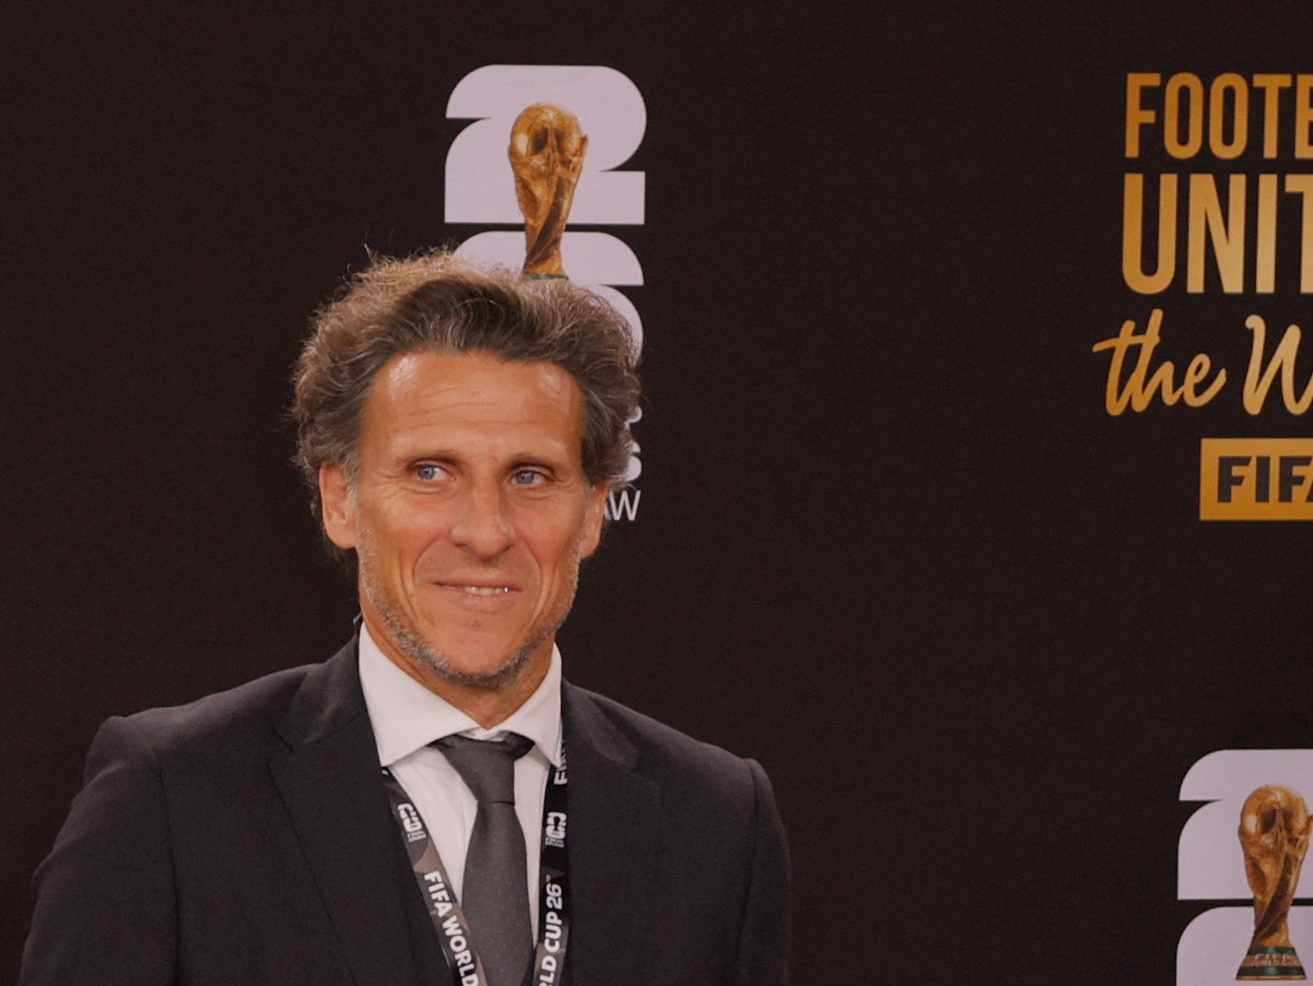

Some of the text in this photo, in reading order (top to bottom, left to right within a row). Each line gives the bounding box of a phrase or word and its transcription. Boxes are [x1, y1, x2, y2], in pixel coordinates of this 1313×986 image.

[1093, 309, 1226, 416] the
[1218, 456, 1313, 503] FIF
[424, 871, 453, 918] FIFA
[544, 911, 562, 953] CUP
